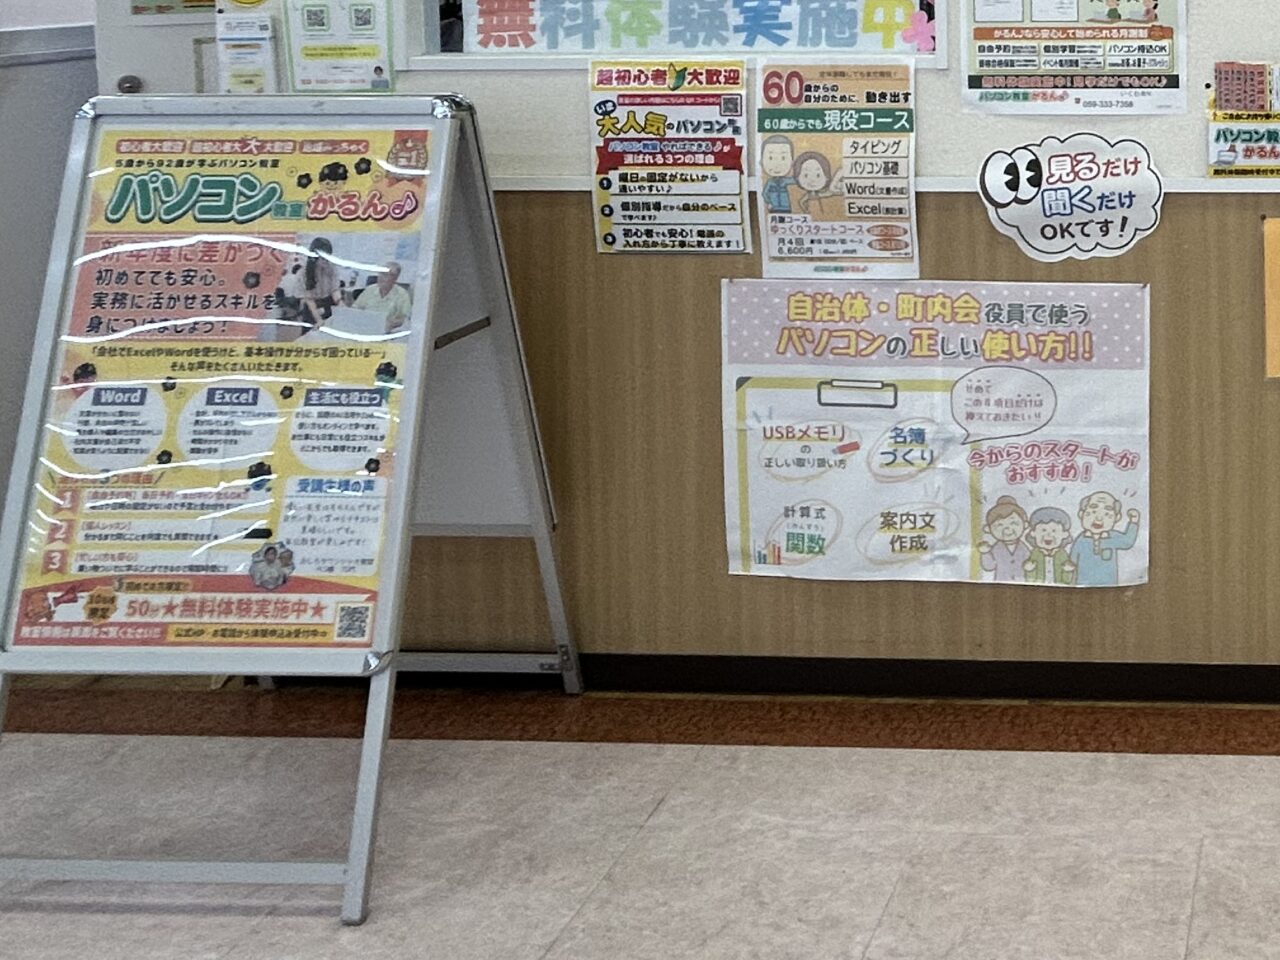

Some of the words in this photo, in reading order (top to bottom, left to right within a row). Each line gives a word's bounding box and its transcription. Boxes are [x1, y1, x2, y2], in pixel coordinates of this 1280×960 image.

[596, 68, 668, 86] 超初心者
[687, 68, 741, 86] 大歓迎
[763, 70, 804, 106] 60
[804, 84, 839, 93] 歳からの
[865, 91, 912, 104] 動き出す
[764, 118, 822, 130] 60歳からでも
[823, 110, 910, 131] 現役コース
[849, 140, 902, 155] タイピング
[623, 154, 715, 165] 選ばれる3つの理由
[849, 161, 899, 176] パソコン基礎
[1046, 152, 1142, 185] 見るだけ
[105, 171, 283, 224] パソコン
[1041, 186, 1137, 218] 聞くだけ
[770, 215, 809, 224] 月謝コース
[770, 225, 864, 235] ゆっくりスタートコース
[777, 238, 805, 246] 月4回
[90, 292, 275, 311] 実務に活かせるスキルを
[787, 292, 1091, 326] 自治体・町内会役員で使う
[100, 390, 142, 404] Word
[213, 389, 255, 404] Excel
[762, 424, 847, 442] USBメモリ
[888, 426, 927, 445] 名簿
[801, 444, 812, 454] の
[879, 449, 936, 467] づくり
[966, 438, 1141, 470] 今からのスタートが
[763, 455, 848, 470] 正しい取り扱い方
[783, 505, 826, 521] 計算式
[879, 511, 937, 531] 案内文
[785, 532, 827, 556] 関数
[889, 533, 929, 553] 作成
[49, 552, 62, 569] 3
